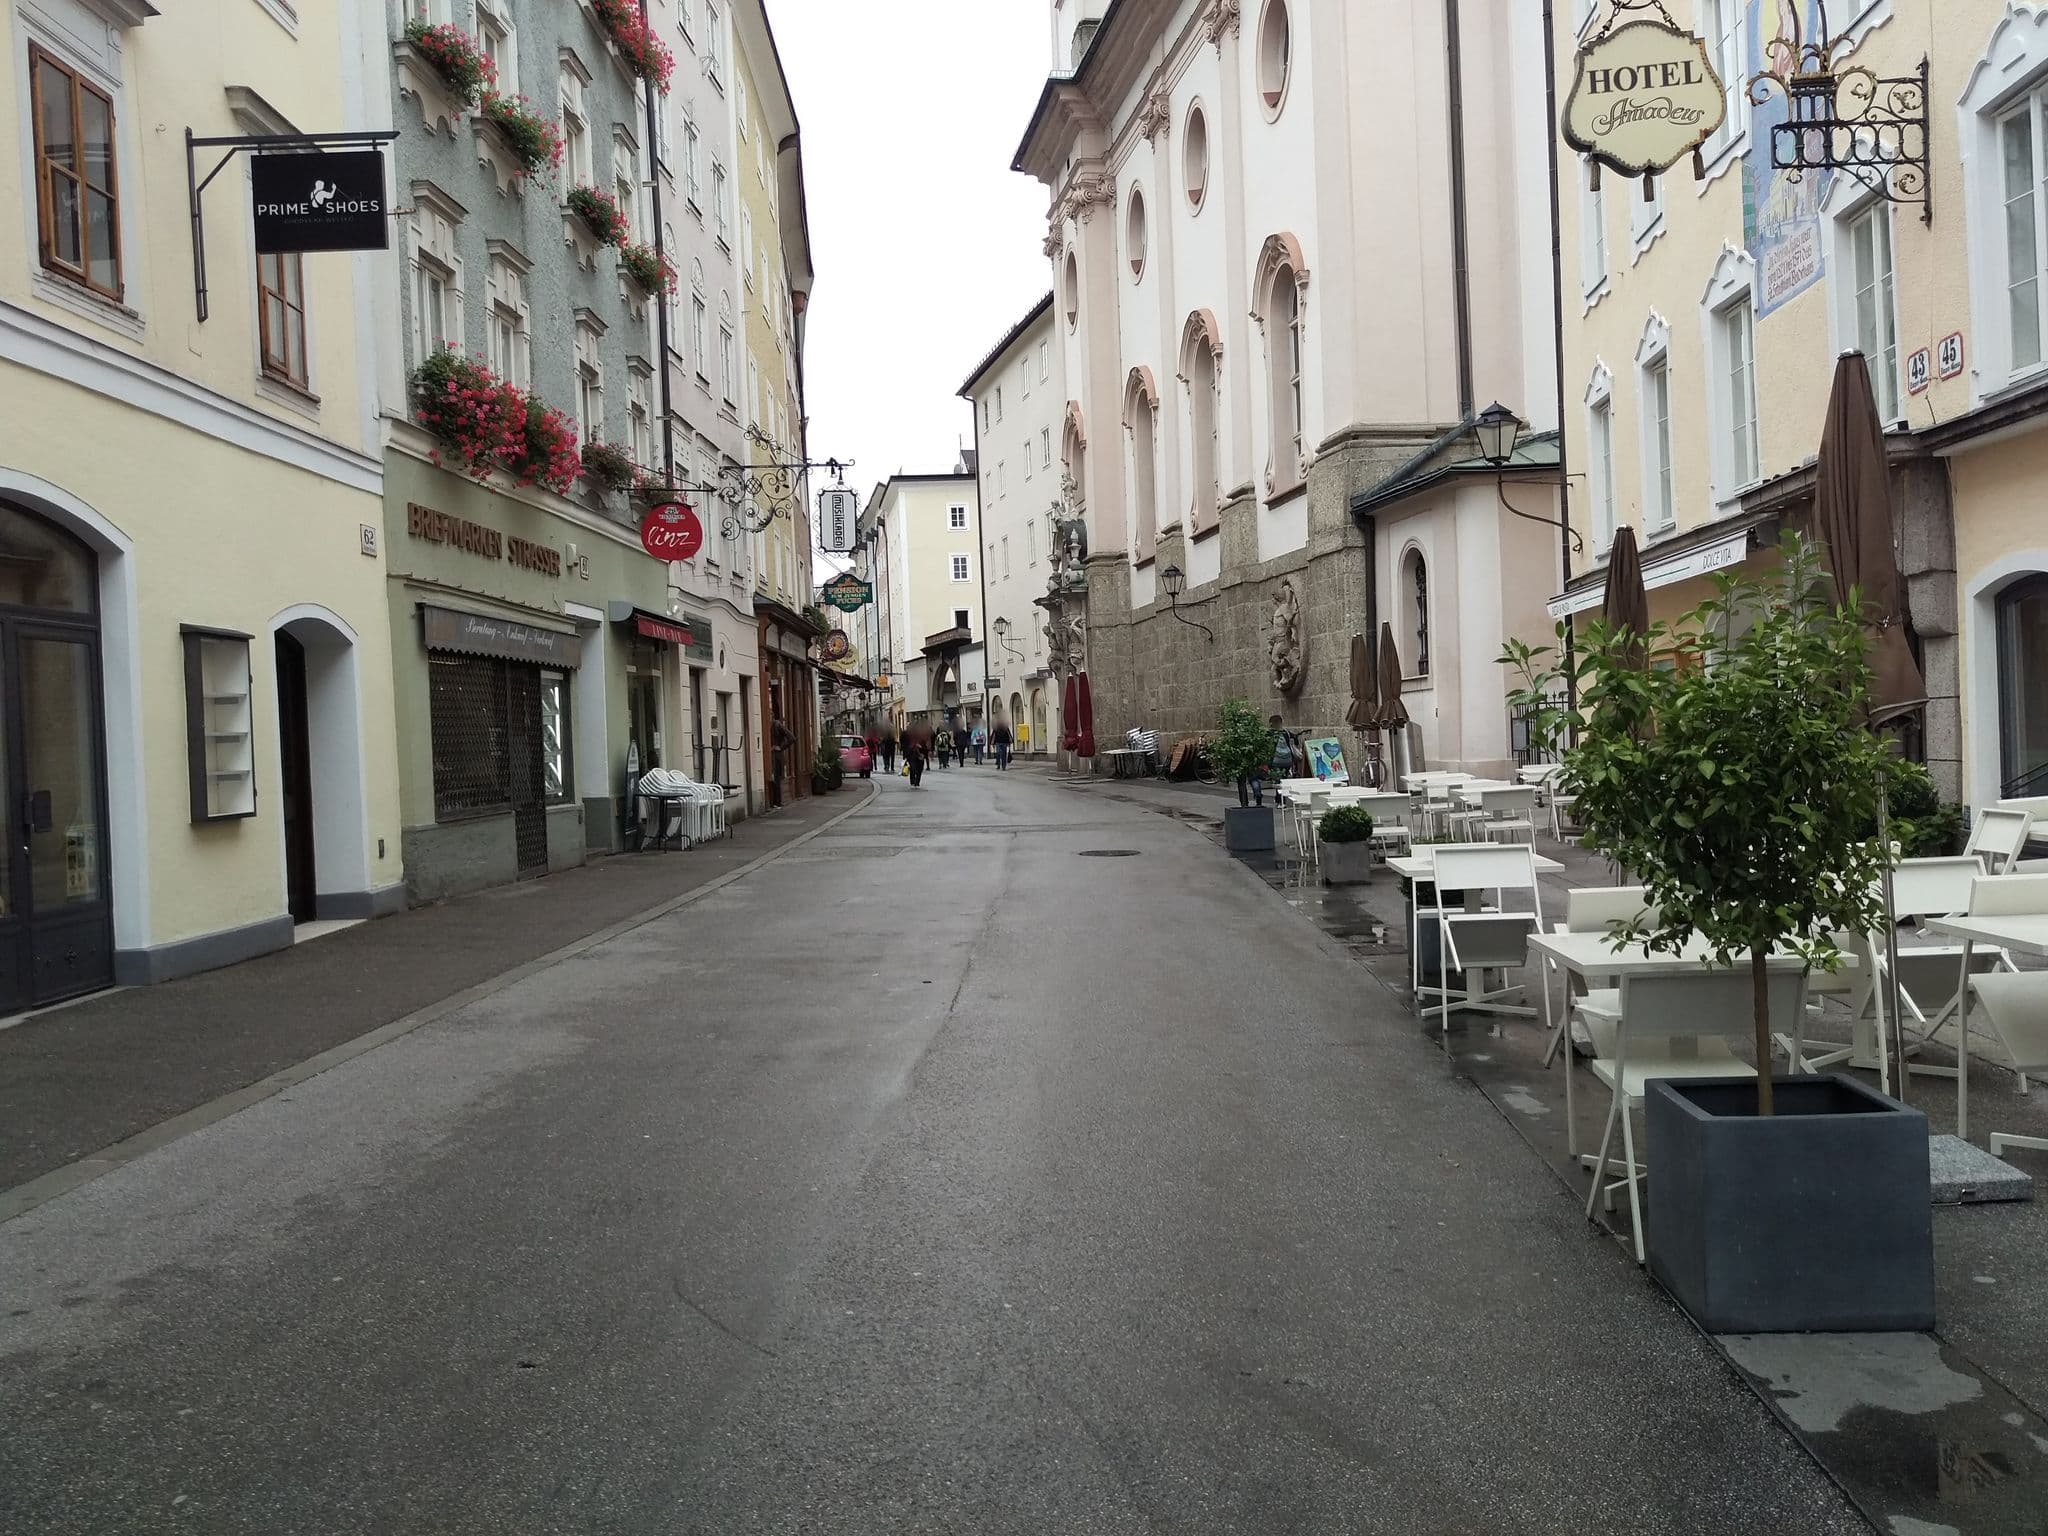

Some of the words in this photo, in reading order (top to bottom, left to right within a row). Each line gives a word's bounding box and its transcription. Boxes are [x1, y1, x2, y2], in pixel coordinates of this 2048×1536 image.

[1587, 60, 1703, 95] HOTEL
[1592, 97, 1705, 136] Amadeus
[258, 204, 309, 216] PRIME
[326, 201, 379, 213] SHOES
[1942, 338, 1956, 365] 45
[1912, 353, 1925, 380] 43
[364, 529, 374, 545] 62
[408, 502, 503, 560] BRIEFMARKEN
[507, 535, 561, 577] STRASSER
[1702, 551, 1720, 569] DOLCE
[1720, 547, 1732, 563] VITA
